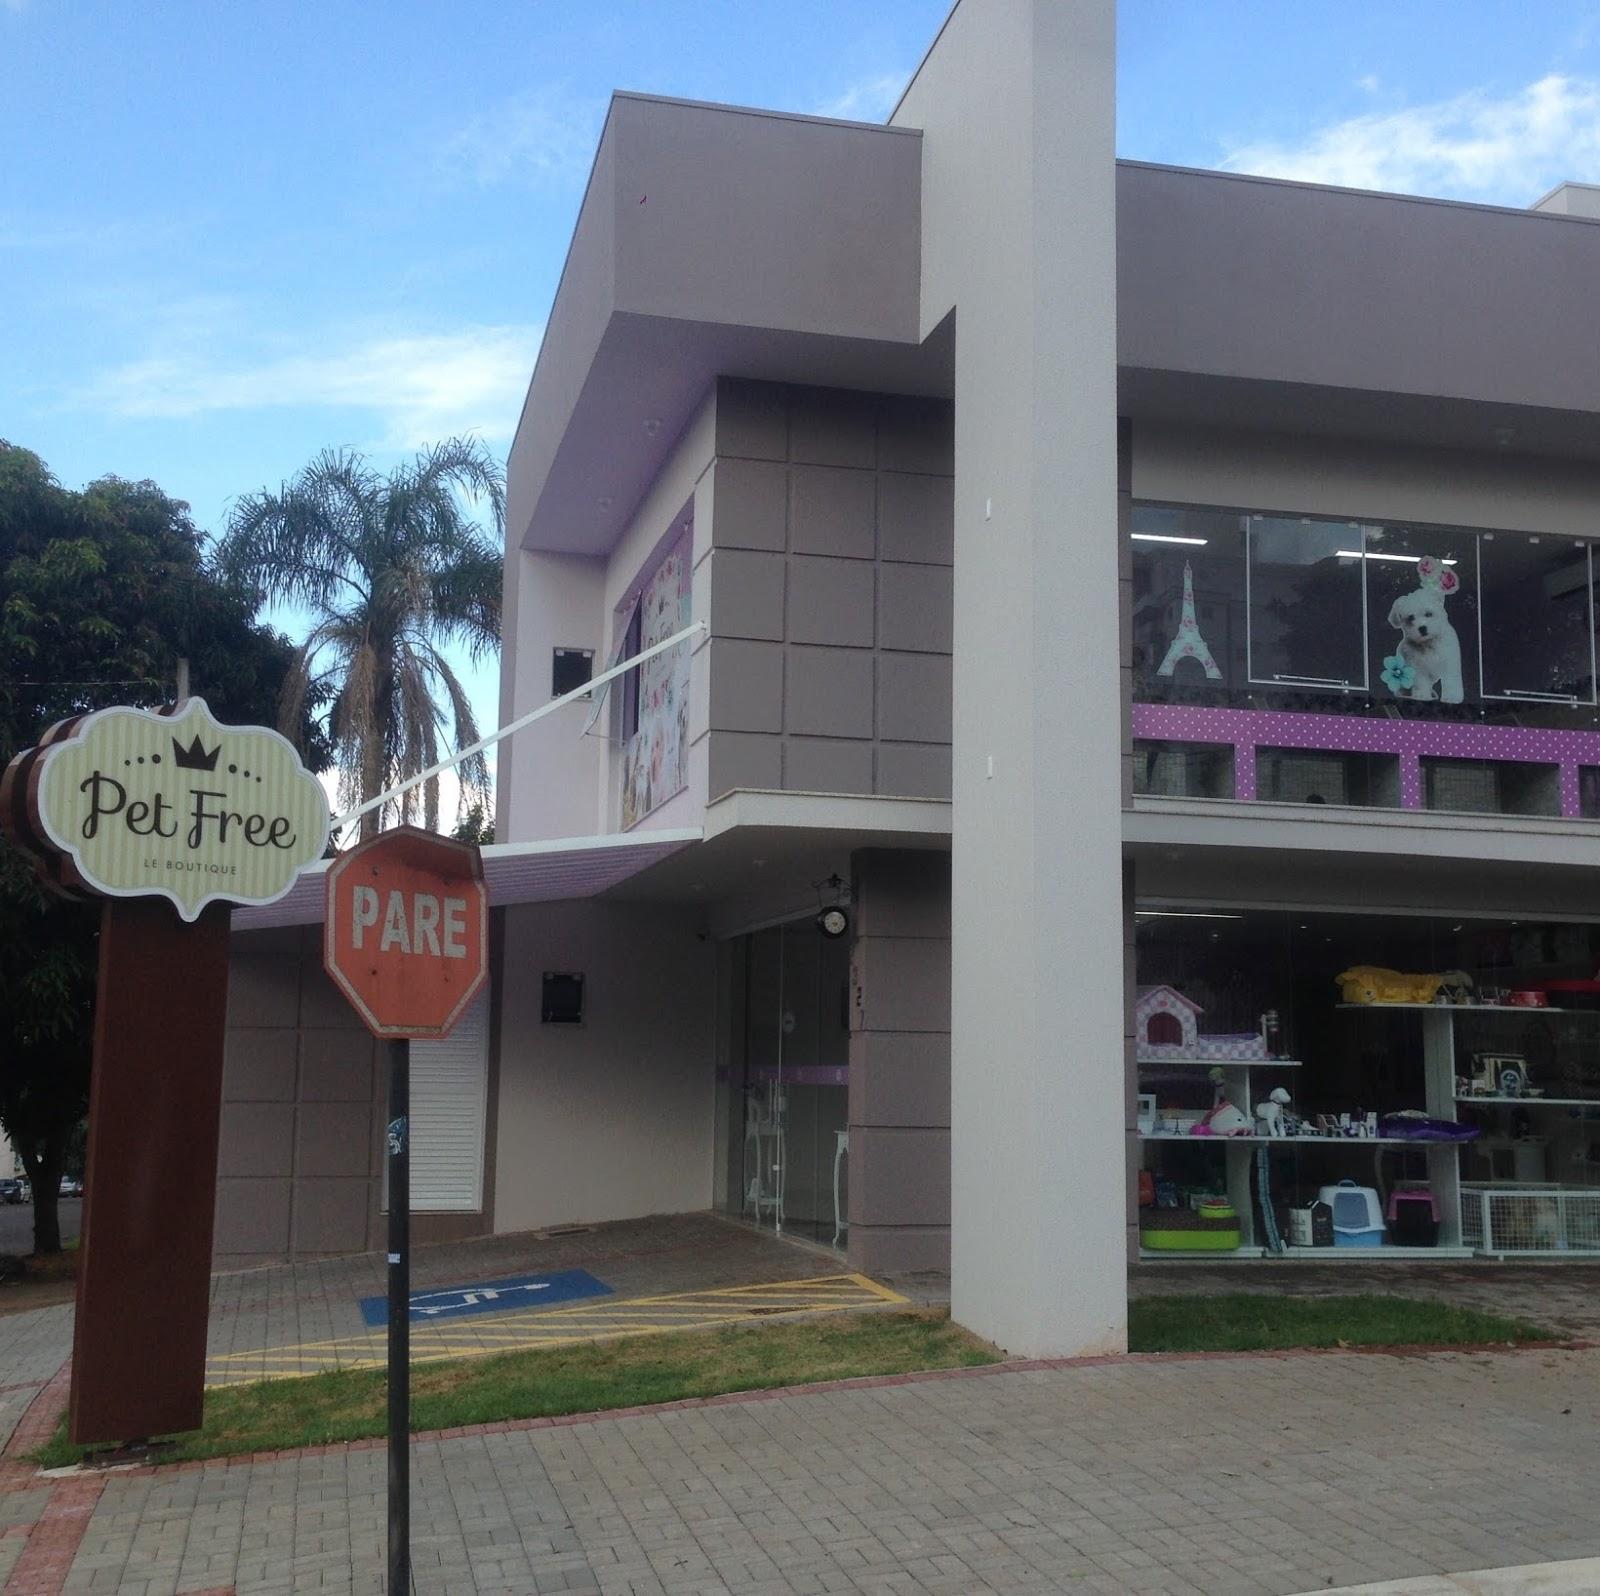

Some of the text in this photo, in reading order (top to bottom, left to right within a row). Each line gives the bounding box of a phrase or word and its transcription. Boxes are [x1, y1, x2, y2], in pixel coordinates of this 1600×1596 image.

[80, 770, 297, 849] Pet Free
[144, 859, 237, 875] LE BOUTIQUE
[352, 885, 466, 959] PARE
